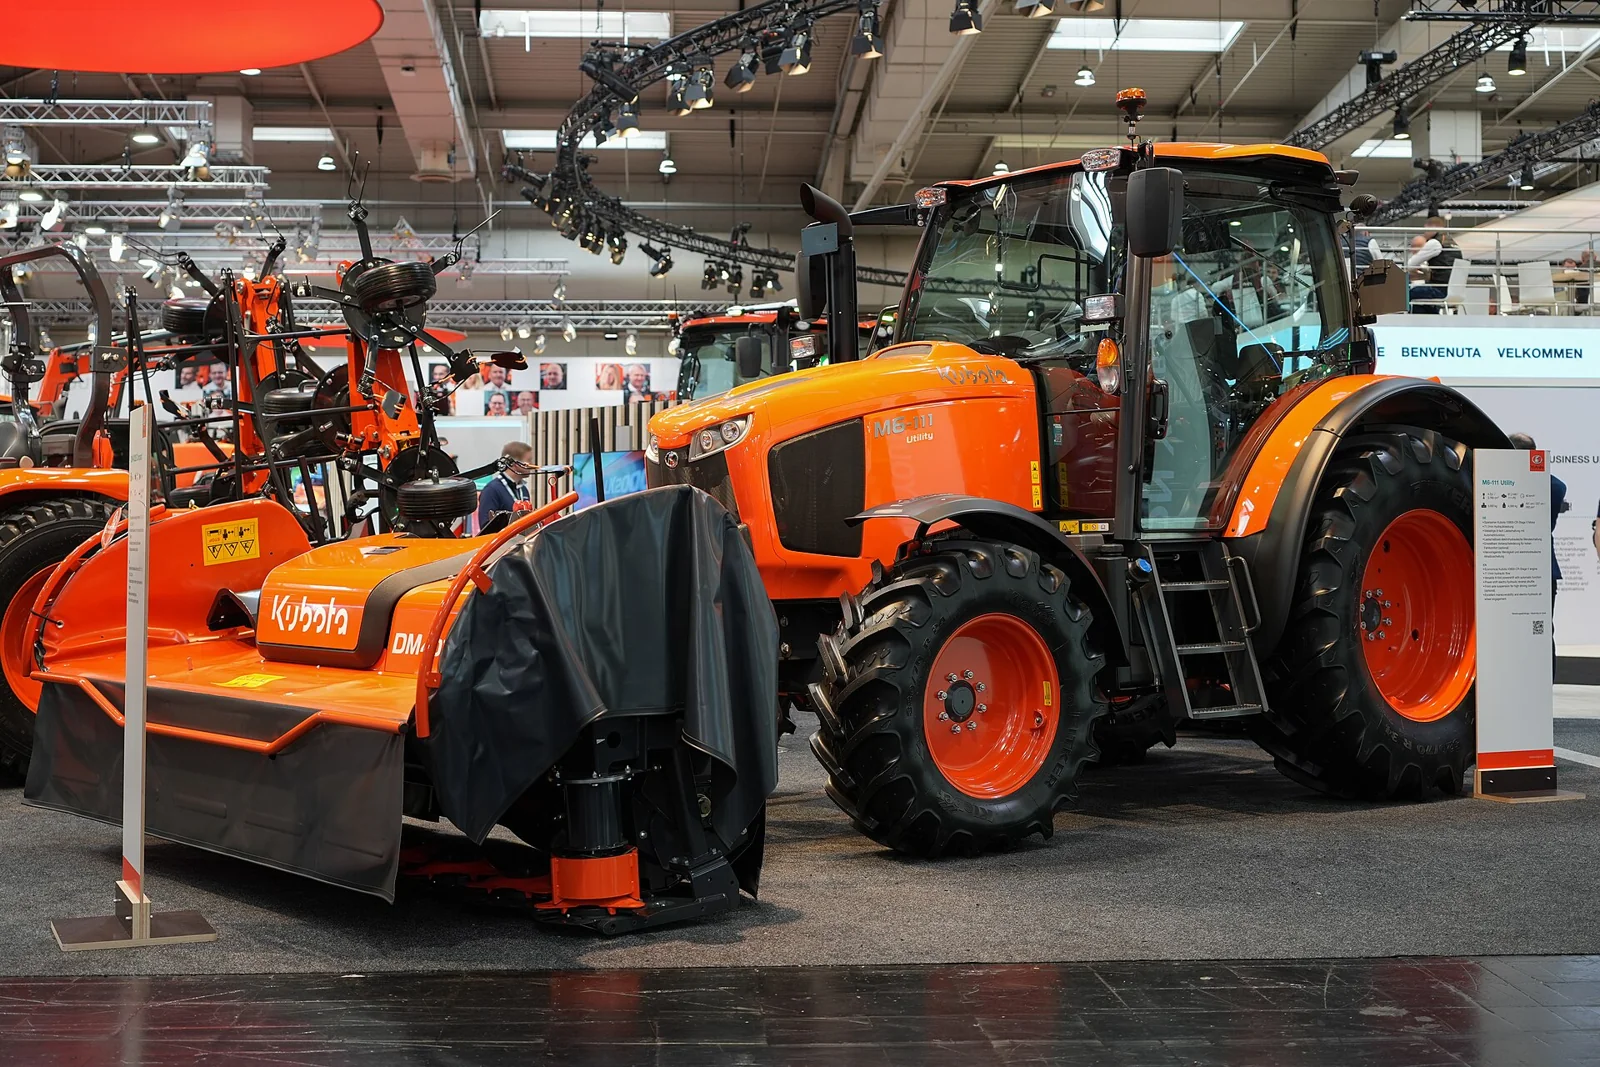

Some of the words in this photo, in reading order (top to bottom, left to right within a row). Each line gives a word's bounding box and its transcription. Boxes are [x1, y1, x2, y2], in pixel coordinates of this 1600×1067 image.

[1401, 347, 1481, 358] BENVENUTA
[1497, 347, 1583, 359] VELKOMMEN
[935, 363, 1008, 385] Kubota
[874, 413, 933, 438] M6-111
[906, 432, 934, 444] Utility
[1500, 479, 1515, 487] Utility
[271, 594, 349, 636] Kubota
